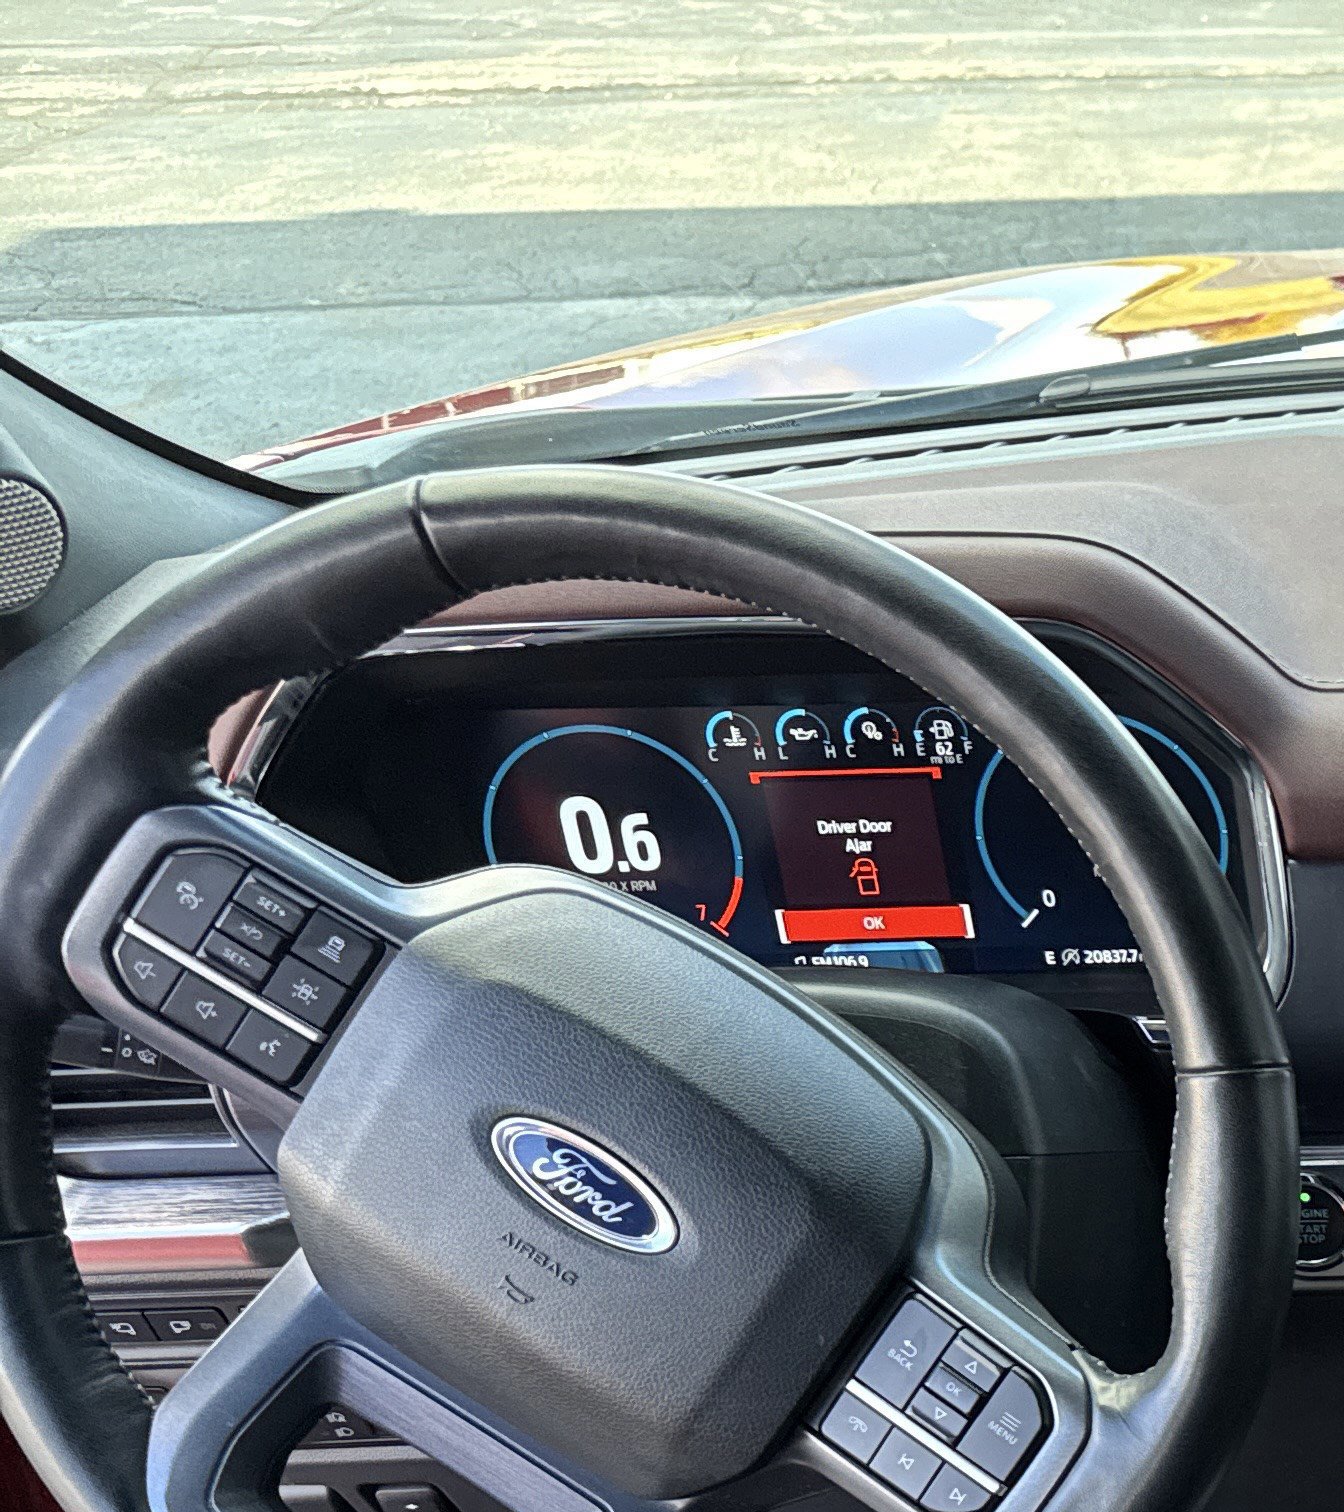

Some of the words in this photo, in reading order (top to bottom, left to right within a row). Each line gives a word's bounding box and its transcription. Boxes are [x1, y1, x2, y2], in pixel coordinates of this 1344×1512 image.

[753, 747, 766, 761] H
[778, 747, 789, 761] L
[824, 744, 837, 758] H
[845, 744, 857, 758] C
[892, 743, 905, 757] H
[915, 743, 926, 757] E
[934, 742, 955, 756] 62
[963, 741, 973, 755] F
[708, 749, 719, 762] C
[816, 819, 857, 835] Driver
[858, 819, 892, 833] Door
[559, 795, 662, 875] 0.6
[845, 838, 872, 854] Ajar
[630, 880, 657, 892] RPM
[1041, 889, 1057, 908] 0
[695, 904, 706, 921] 7
[863, 916, 886, 930] OK
[1044, 950, 1057, 965] E
[532, 1148, 634, 1224] Ford
[501, 1231, 580, 1287] AIRBAG
[887, 1347, 914, 1371] BACK
[945, 1382, 962, 1396] OK
[987, 1420, 1019, 1445] MENU
